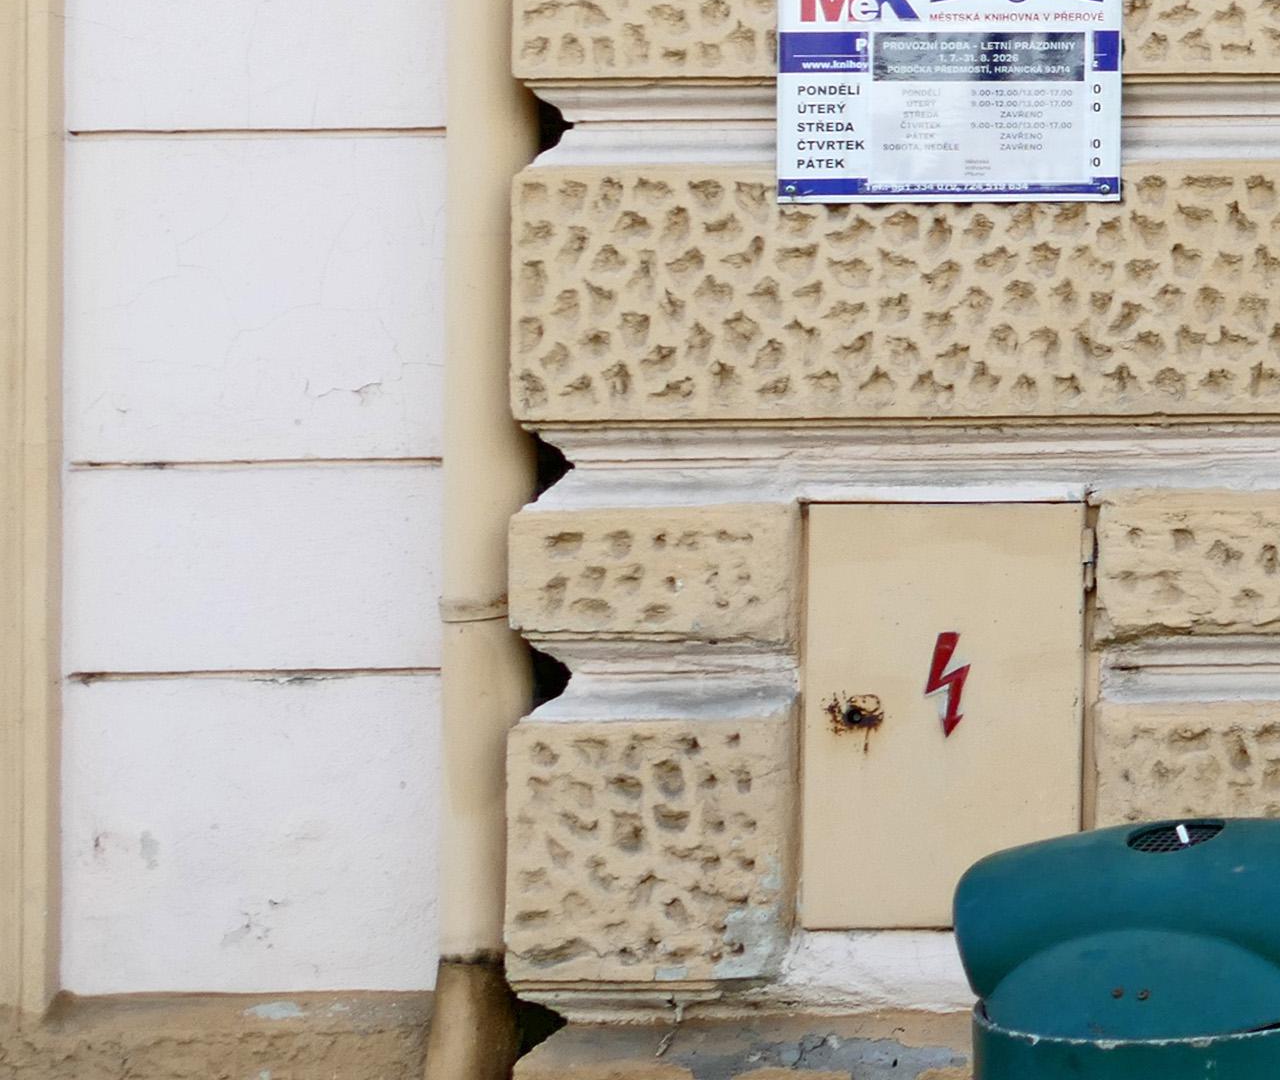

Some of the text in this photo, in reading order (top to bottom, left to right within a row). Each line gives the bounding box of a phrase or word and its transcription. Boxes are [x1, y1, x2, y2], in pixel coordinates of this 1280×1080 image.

[929, 11, 1105, 22] MĚSTSKÁ KNIHOVNA V PŘEROVĚ
[883, 39, 938, 50] PROVOZNÍ
[940, 41, 970, 50] DOBA
[981, 39, 1012, 50] LETNÍ
[1014, 39, 1076, 50] PRÁZDNINY
[887, 64, 933, 74] POBOČKA
[994, 64, 1043, 74] HRANICKÁ
[797, 83, 861, 96] PONDĚLÍ
[797, 101, 846, 114] ÚTERÝ
[1000, 110, 1043, 118] ZAVŘENO
[797, 120, 855, 133] STŘEDA
[1000, 131, 1043, 140] ZAVŘENO
[796, 138, 865, 151] ČTVRTEK
[1000, 142, 1043, 151] ZAVŘENO
[796, 157, 845, 169] PÁTEK
